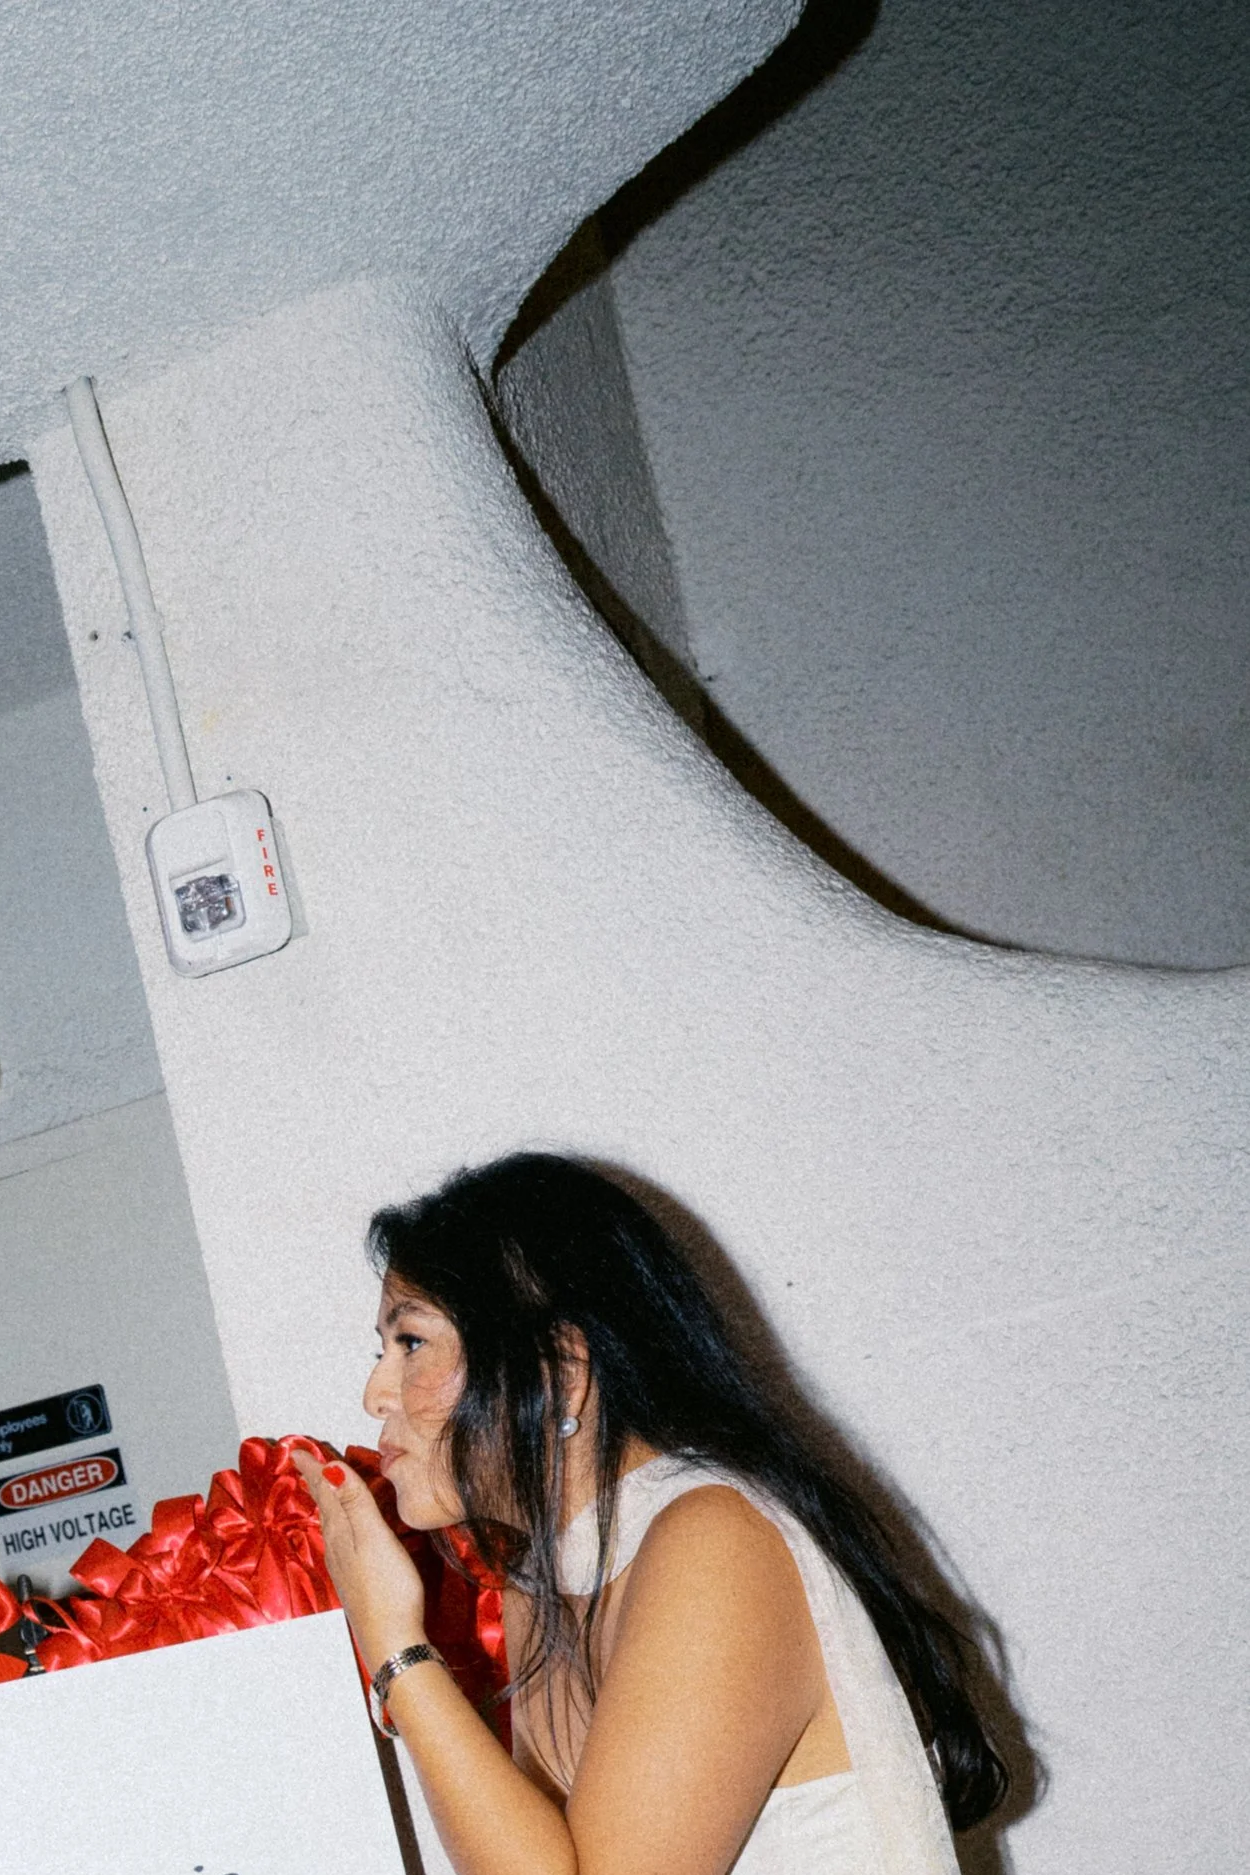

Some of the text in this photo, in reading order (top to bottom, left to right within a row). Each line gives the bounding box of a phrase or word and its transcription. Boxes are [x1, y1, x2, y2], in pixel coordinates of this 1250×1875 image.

[256, 829, 278, 896] FIRE
[10, 1463, 104, 1503] DANGER
[2, 1503, 136, 1555] HIGH VOLTAGE
